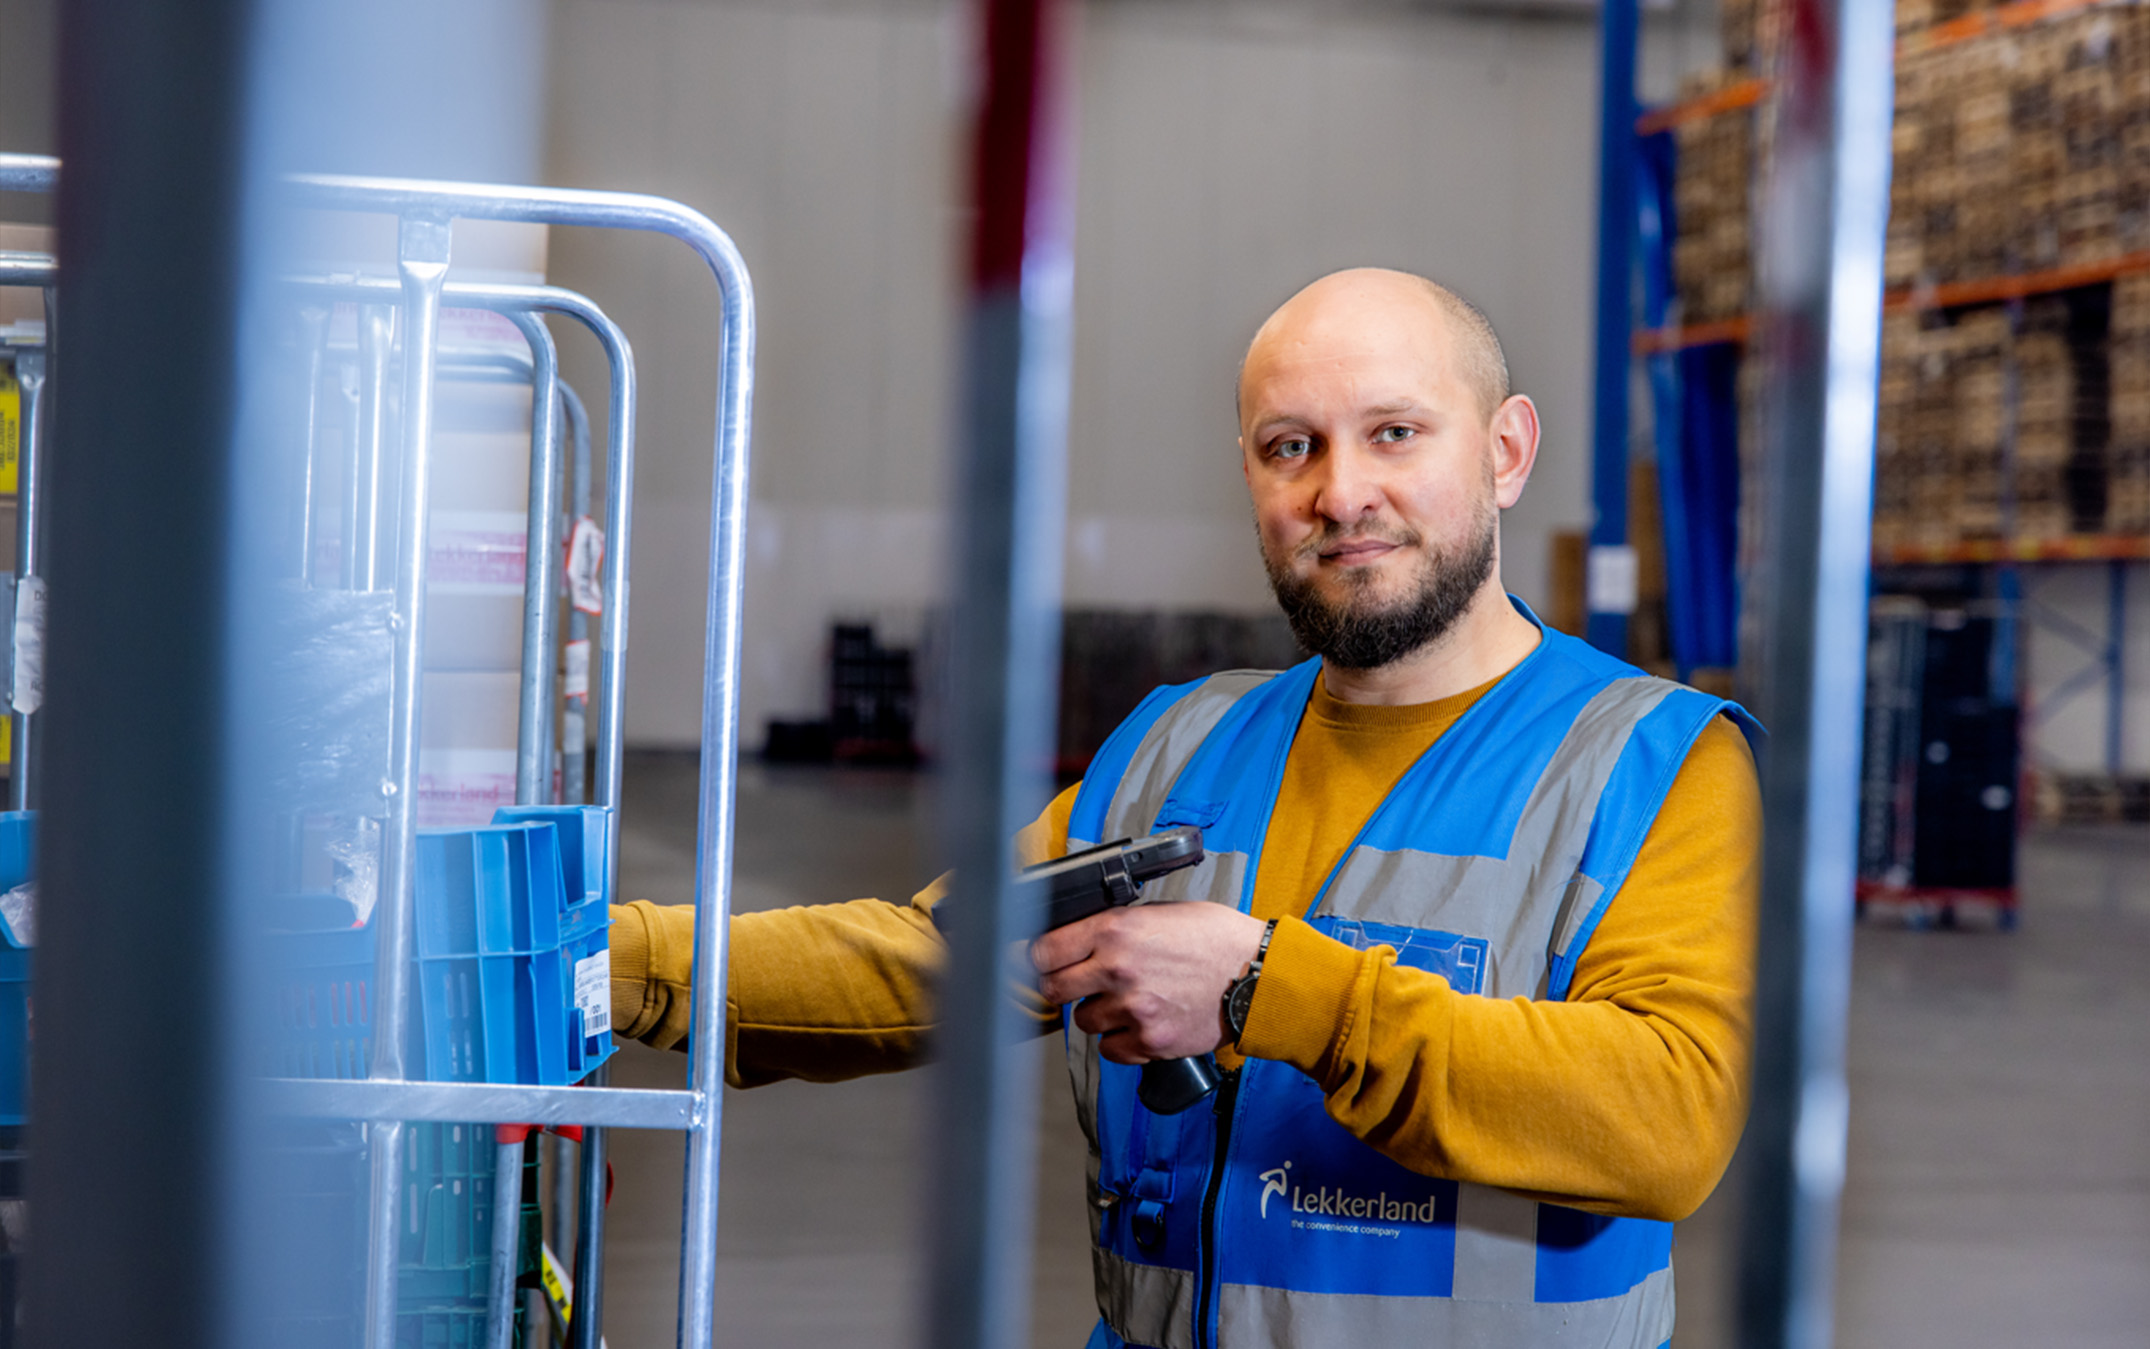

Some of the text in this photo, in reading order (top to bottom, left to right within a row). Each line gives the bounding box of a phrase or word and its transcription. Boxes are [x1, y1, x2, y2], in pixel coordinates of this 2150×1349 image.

[1292, 1186, 1436, 1223] Lekkerland
[1291, 1219, 1401, 1239] the convenience company
